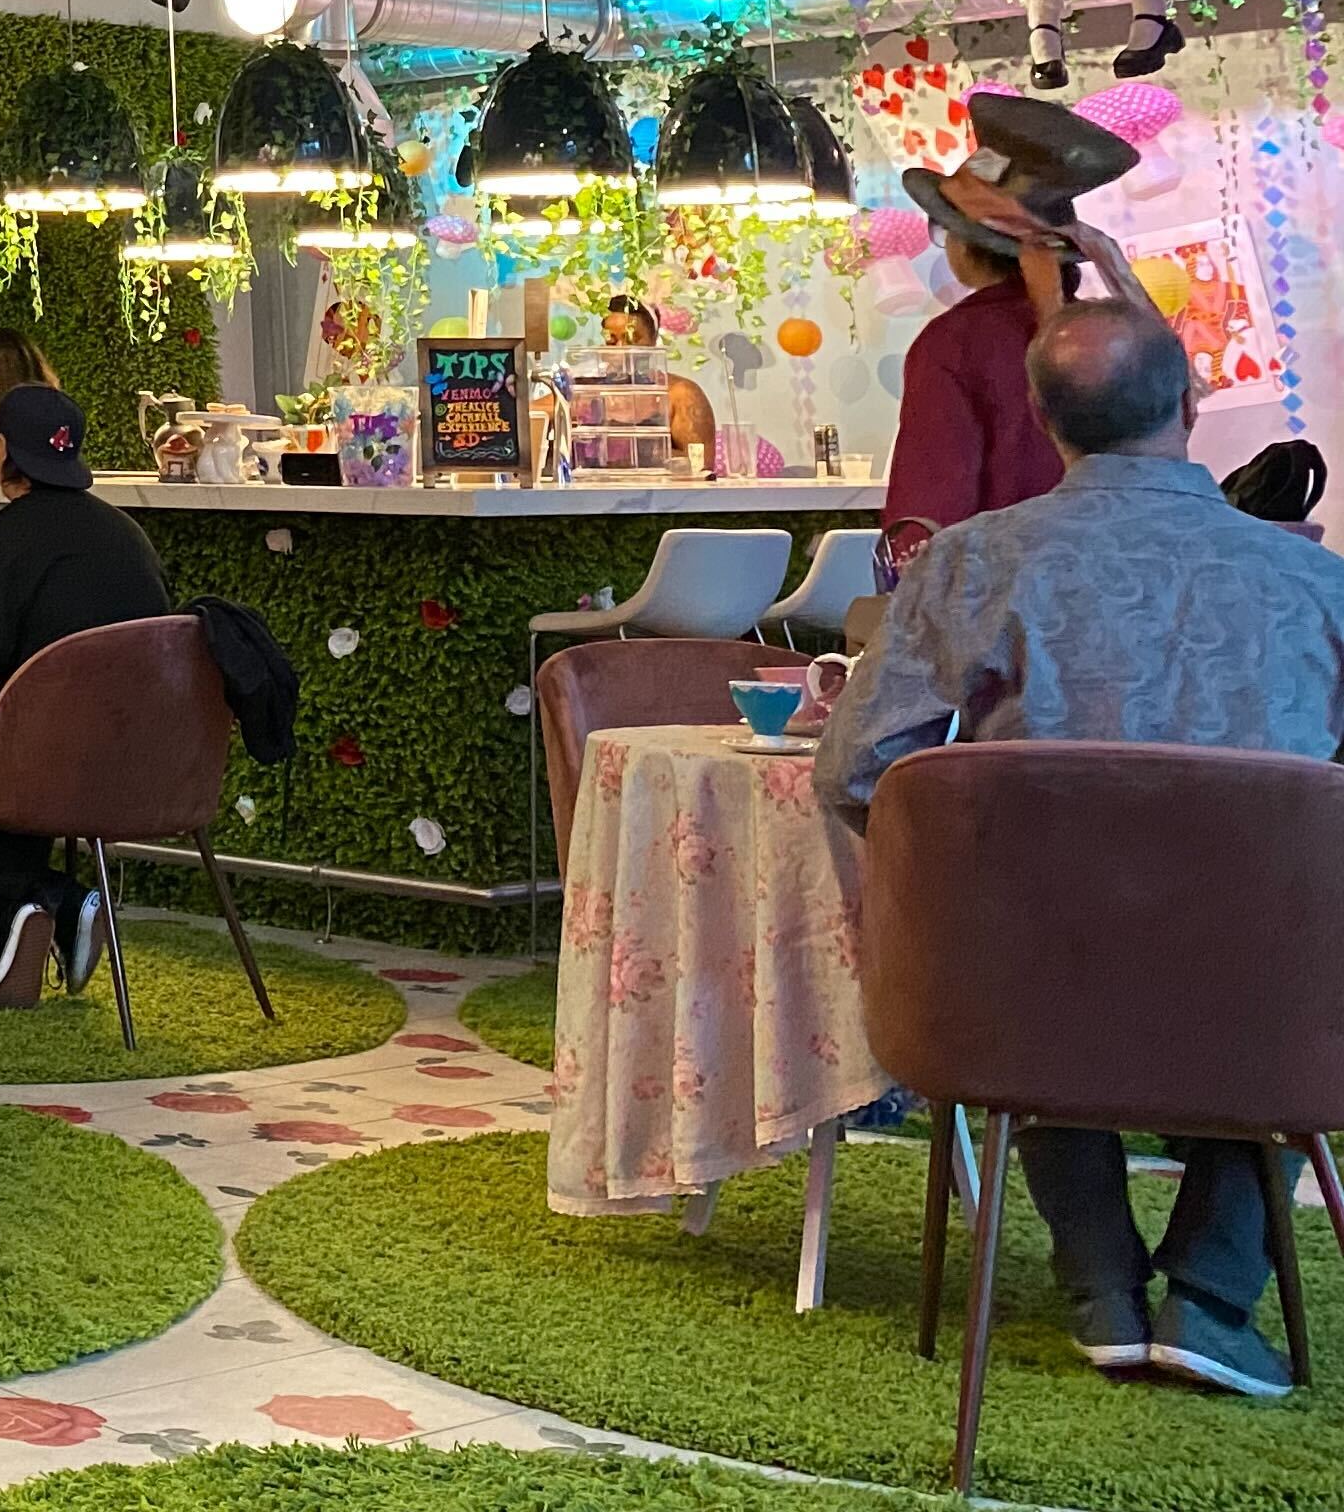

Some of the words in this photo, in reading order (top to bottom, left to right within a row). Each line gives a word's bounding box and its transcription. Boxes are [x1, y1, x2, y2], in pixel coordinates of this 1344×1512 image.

[435, 351, 510, 380] TIPS
[445, 412, 503, 423] COCKTAIL
[437, 421, 511, 433] EXPERIENCE
